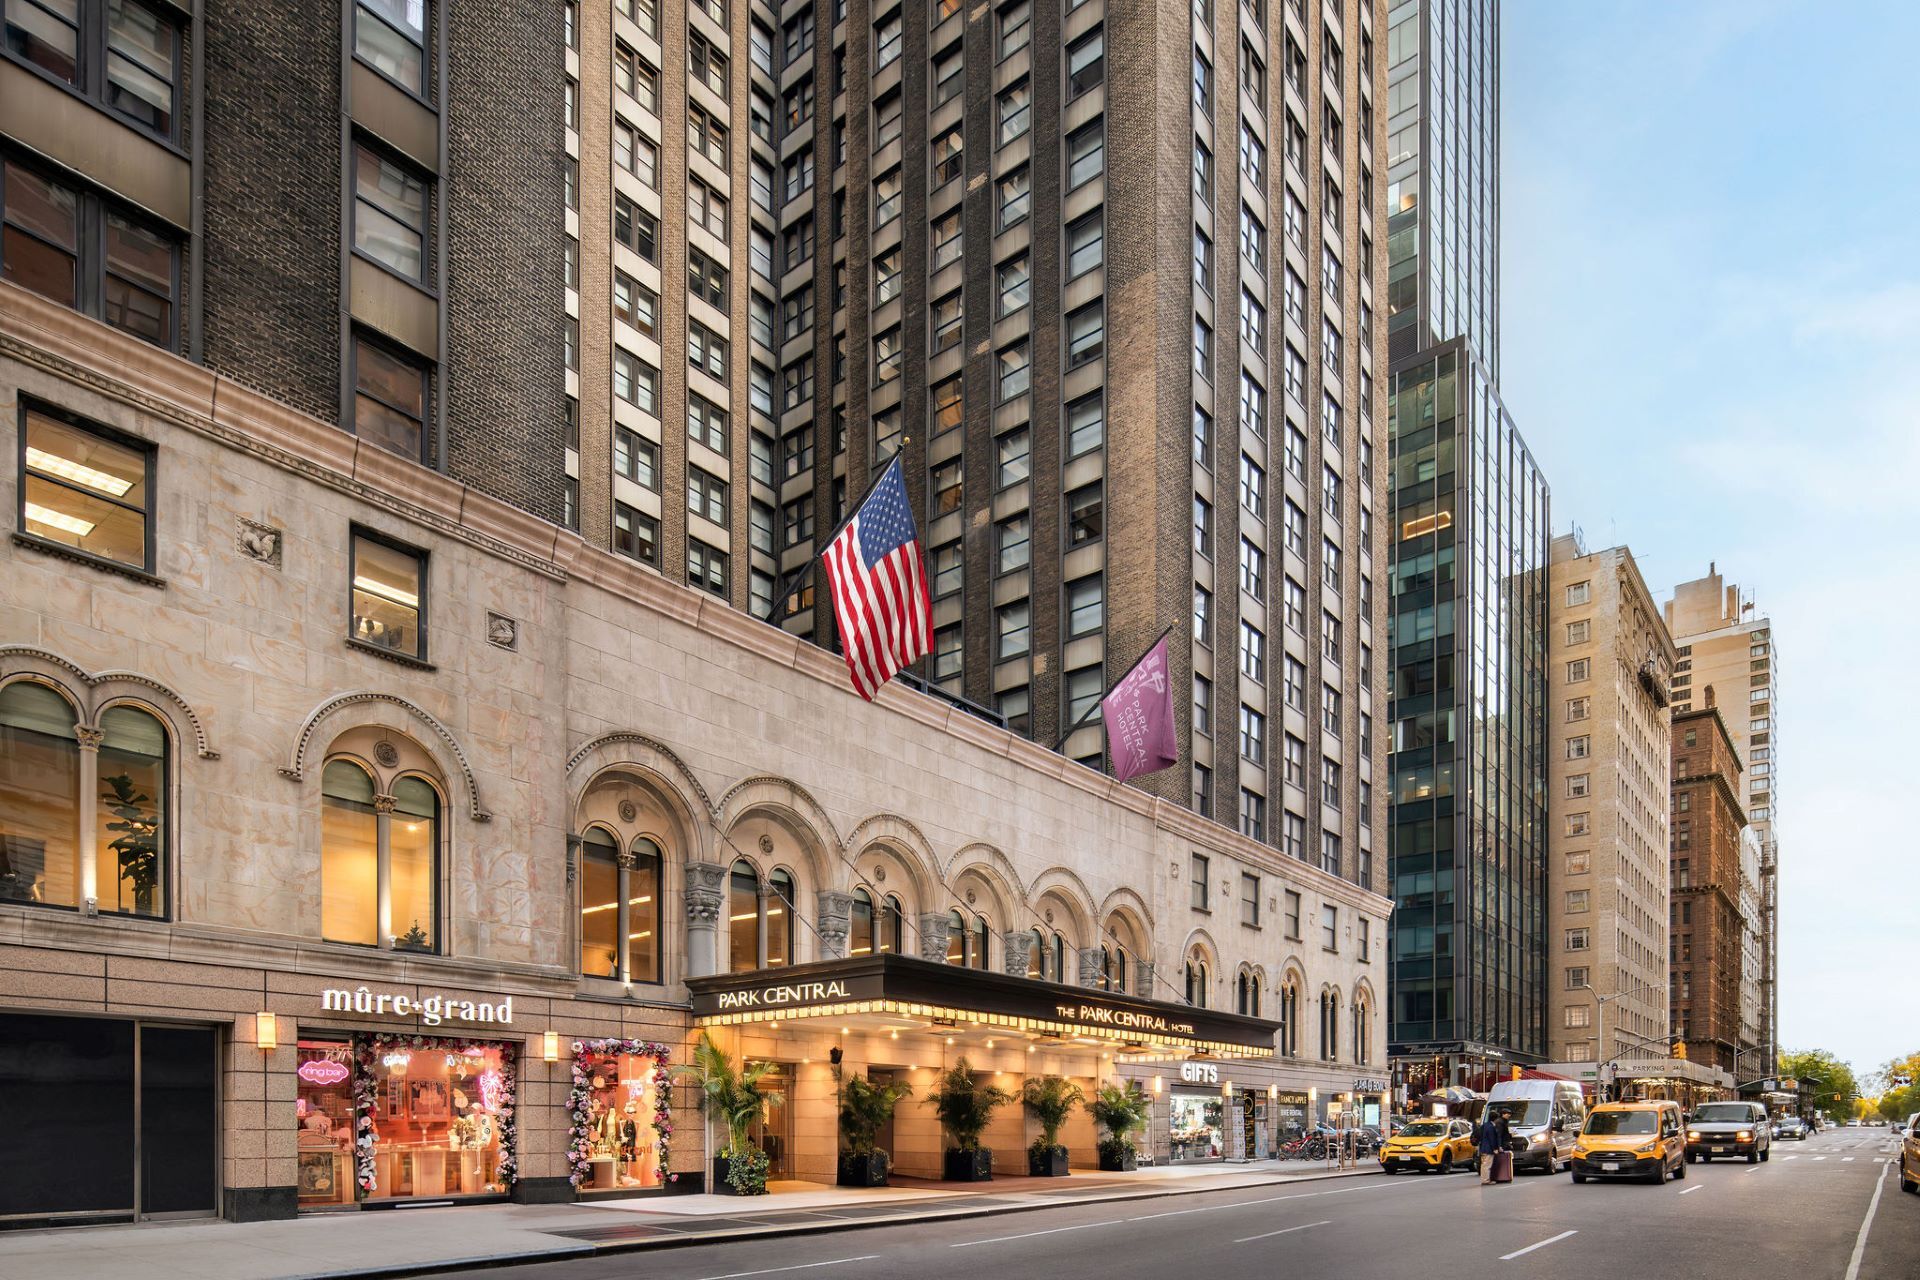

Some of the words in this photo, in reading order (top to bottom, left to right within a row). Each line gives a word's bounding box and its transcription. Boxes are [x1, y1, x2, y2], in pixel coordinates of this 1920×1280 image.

[1131, 699, 1149, 734] PARK
[1116, 712, 1133, 752] HOTEL
[1123, 705, 1147, 768] CENTRAL
[719, 989, 760, 1009] PARK
[763, 980, 851, 1004] CENTRAL
[1056, 1006, 1075, 1019] THE
[1080, 1005, 1114, 1024] PARK
[1114, 1011, 1169, 1031] CENTRAL
[1171, 1023, 1195, 1035] HOTEL
[305, 1067, 325, 1077] ring
[326, 1068, 344, 1076] bar
[1180, 1062, 1218, 1083] GIFTS
[1280, 1095, 1294, 1104] FANCY
[1294, 1095, 1307, 1104] APPLE
